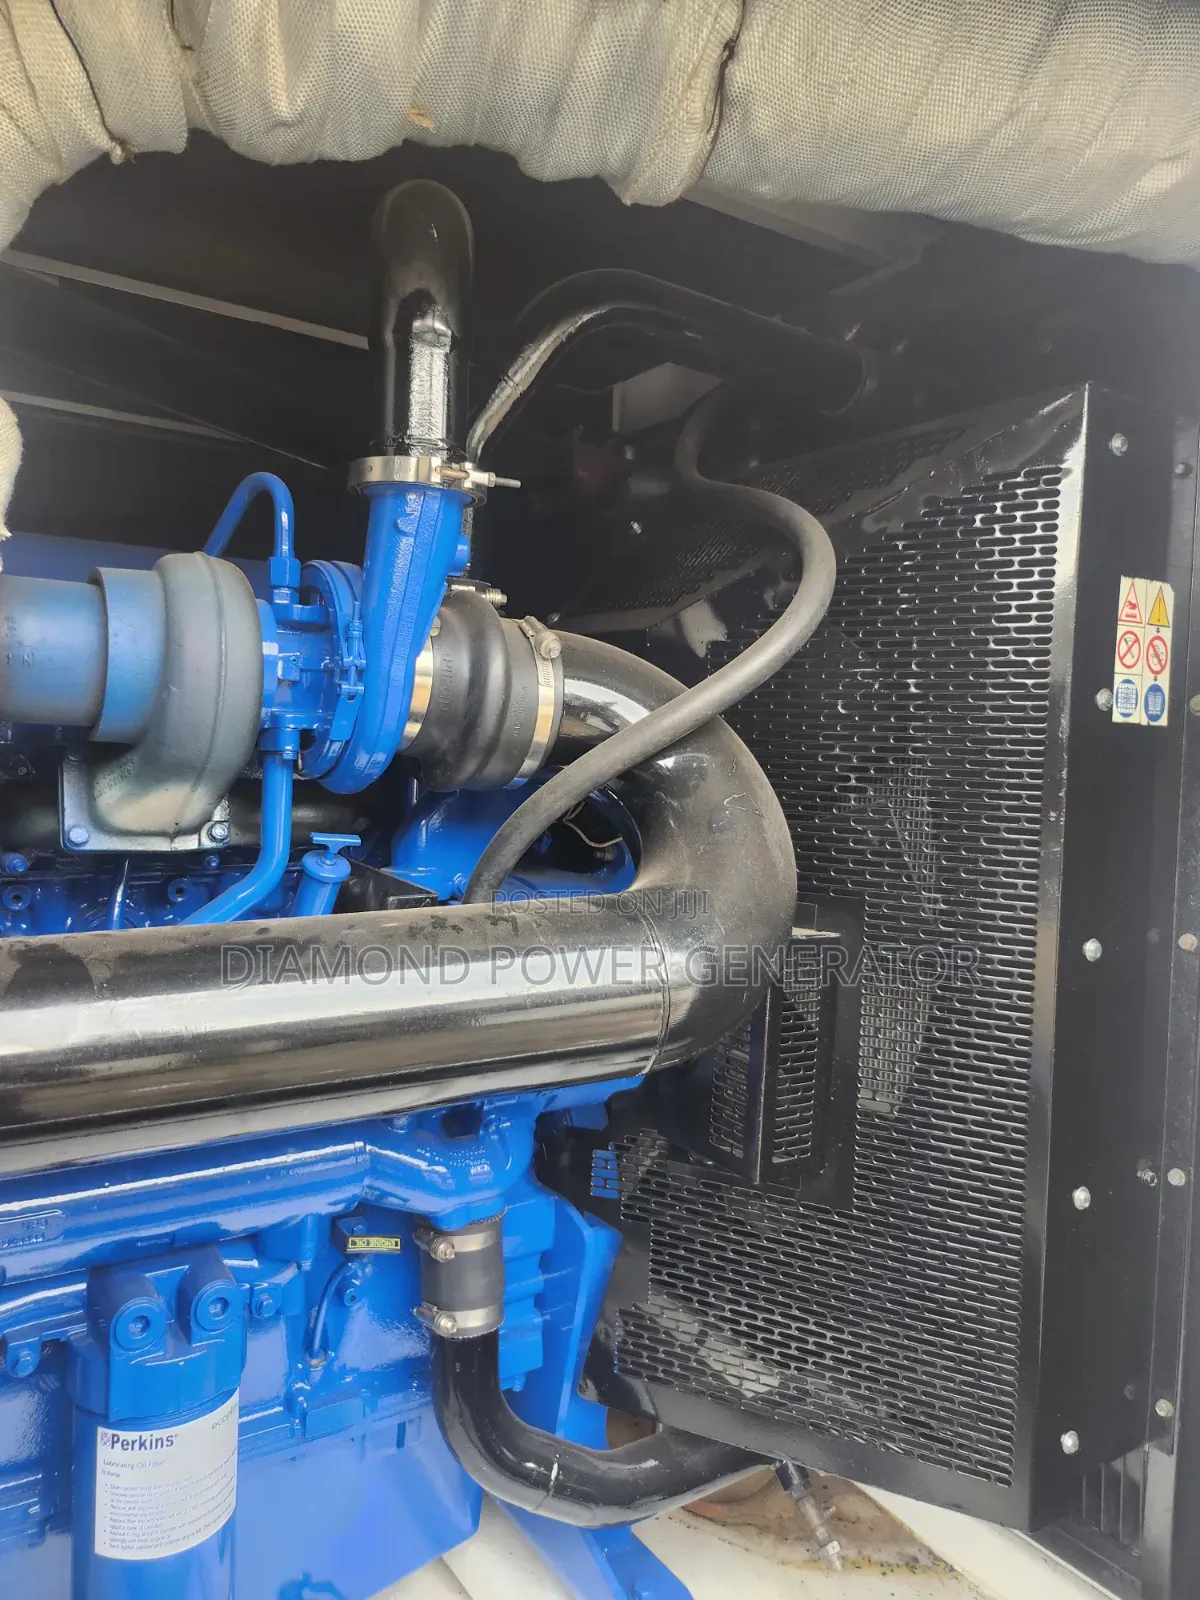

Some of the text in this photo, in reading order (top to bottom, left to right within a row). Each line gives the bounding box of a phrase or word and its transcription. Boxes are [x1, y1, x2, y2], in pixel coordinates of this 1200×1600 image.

[369, 1239, 395, 1247] ENGINE
[103, 1458, 165, 1471] Lubricating Oil Filter
